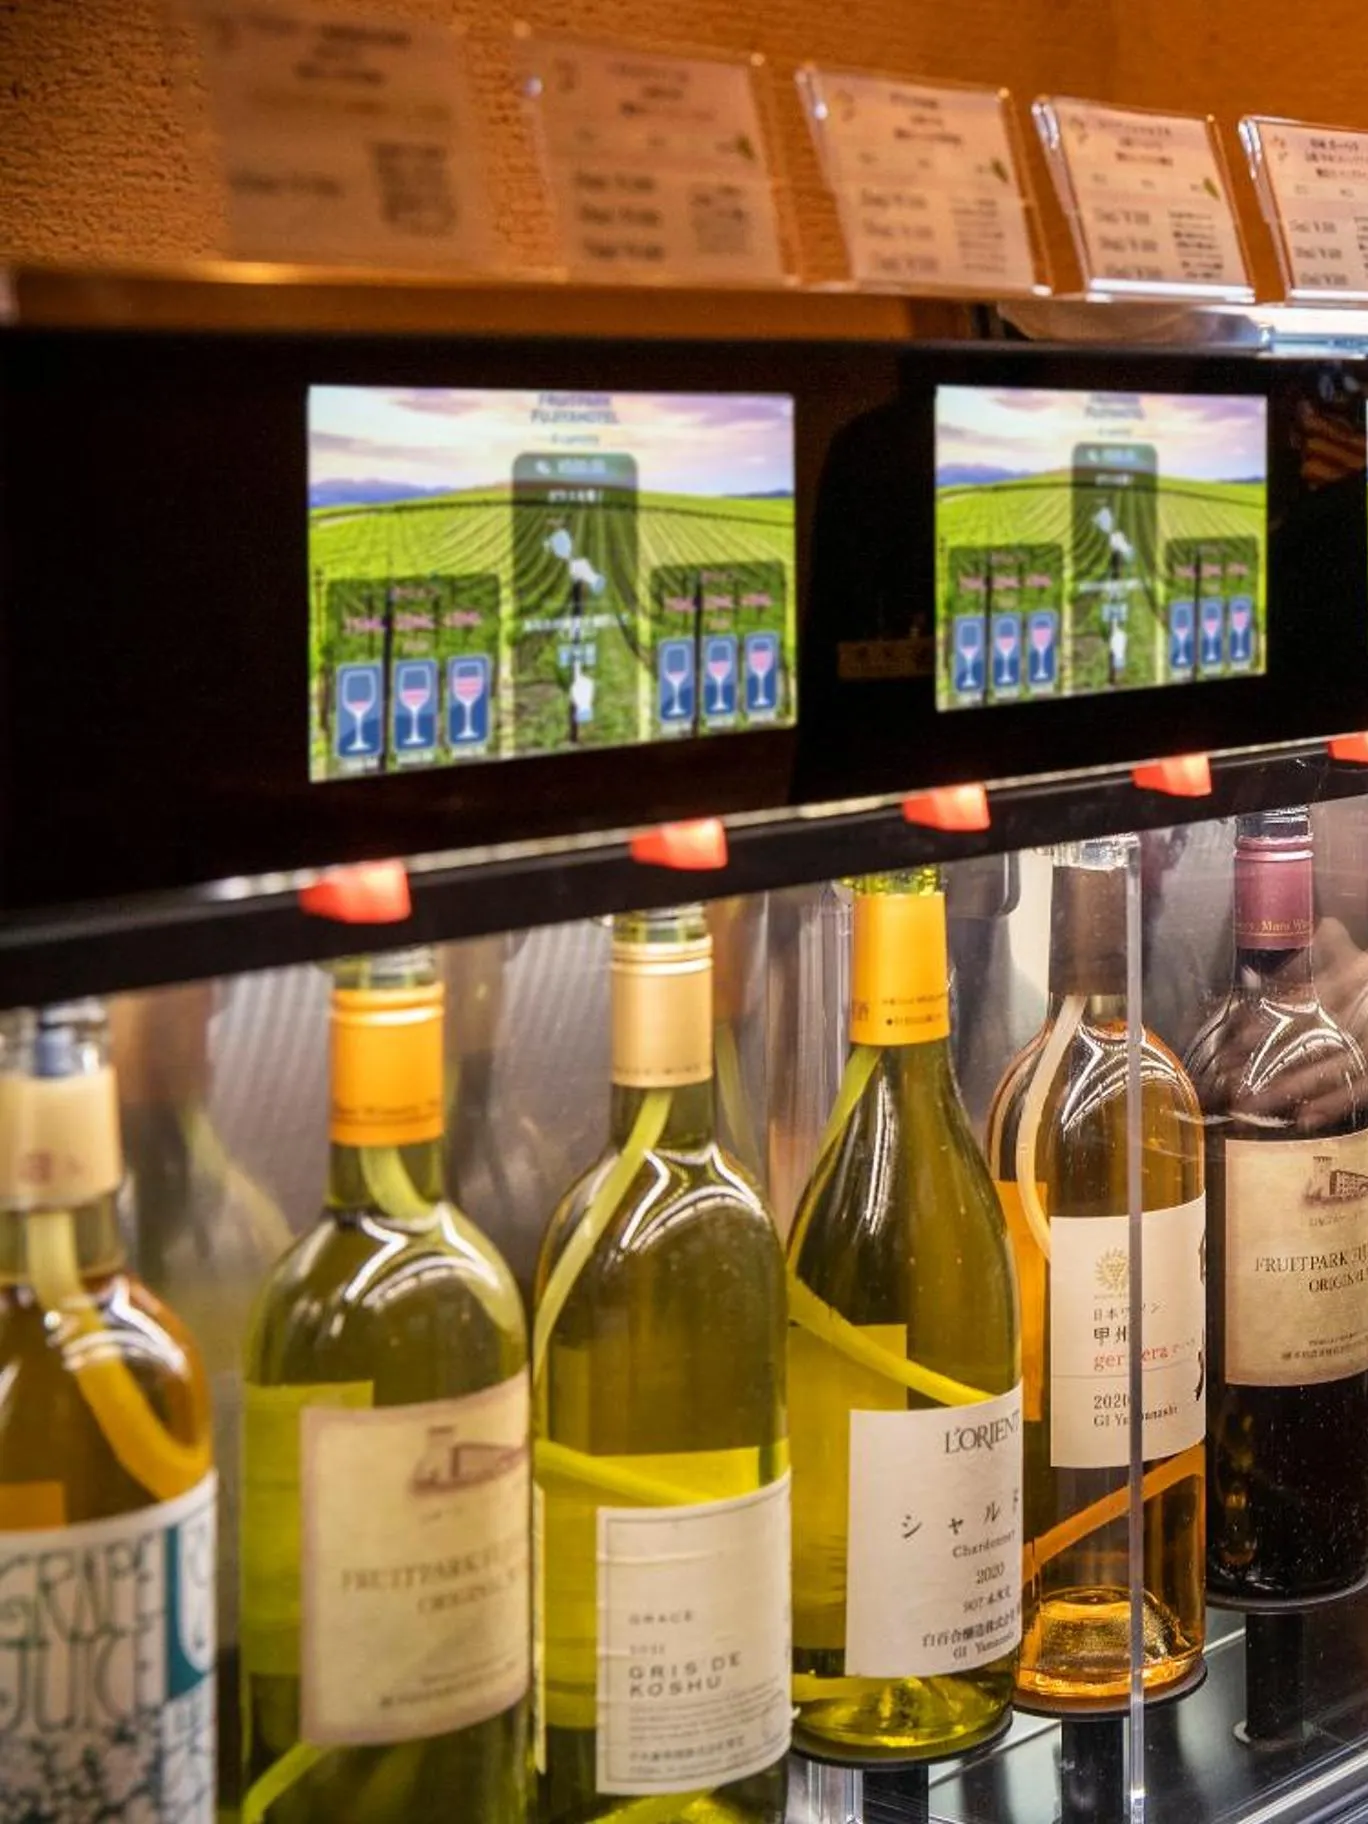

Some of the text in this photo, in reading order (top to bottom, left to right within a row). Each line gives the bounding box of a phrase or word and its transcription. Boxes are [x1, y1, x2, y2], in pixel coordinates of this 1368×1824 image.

[1093, 1346, 1169, 1372] gerera
[1114, 1404, 1178, 1427] Yaanashi
[629, 1675, 722, 1698] KOSHU
